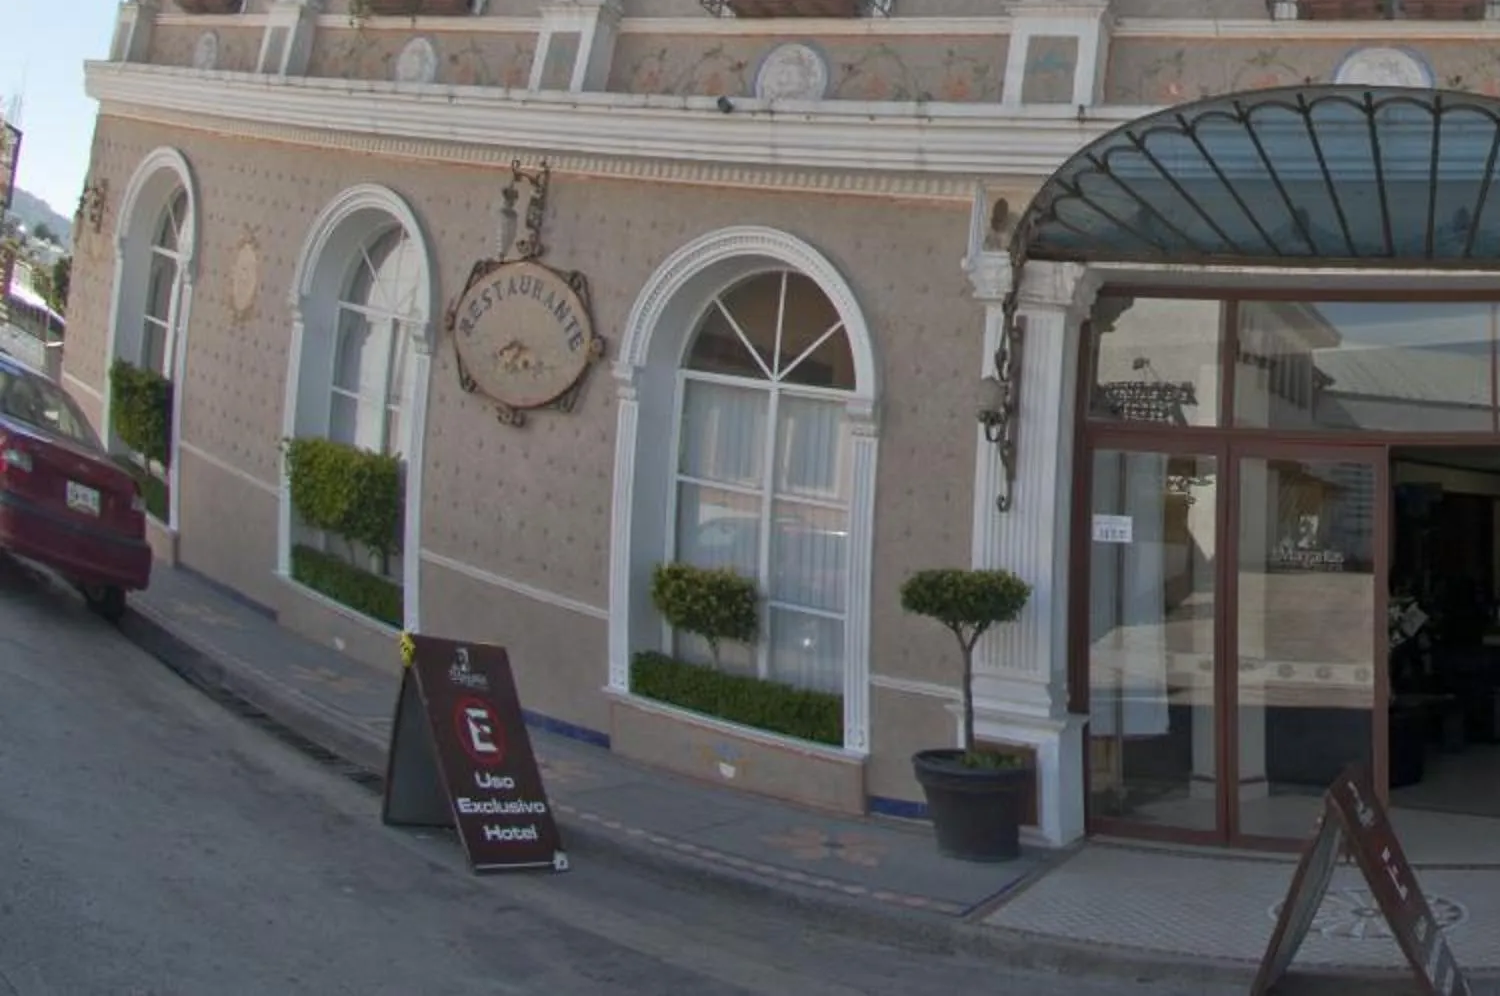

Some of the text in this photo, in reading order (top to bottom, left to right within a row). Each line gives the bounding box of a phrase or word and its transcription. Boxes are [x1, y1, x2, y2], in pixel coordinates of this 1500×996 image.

[459, 275, 585, 352] RESTAURANTE
[465, 708, 498, 752] E
[474, 772, 515, 788] Uso
[457, 797, 546, 813] Exclusivo
[483, 824, 538, 840] Hotel
